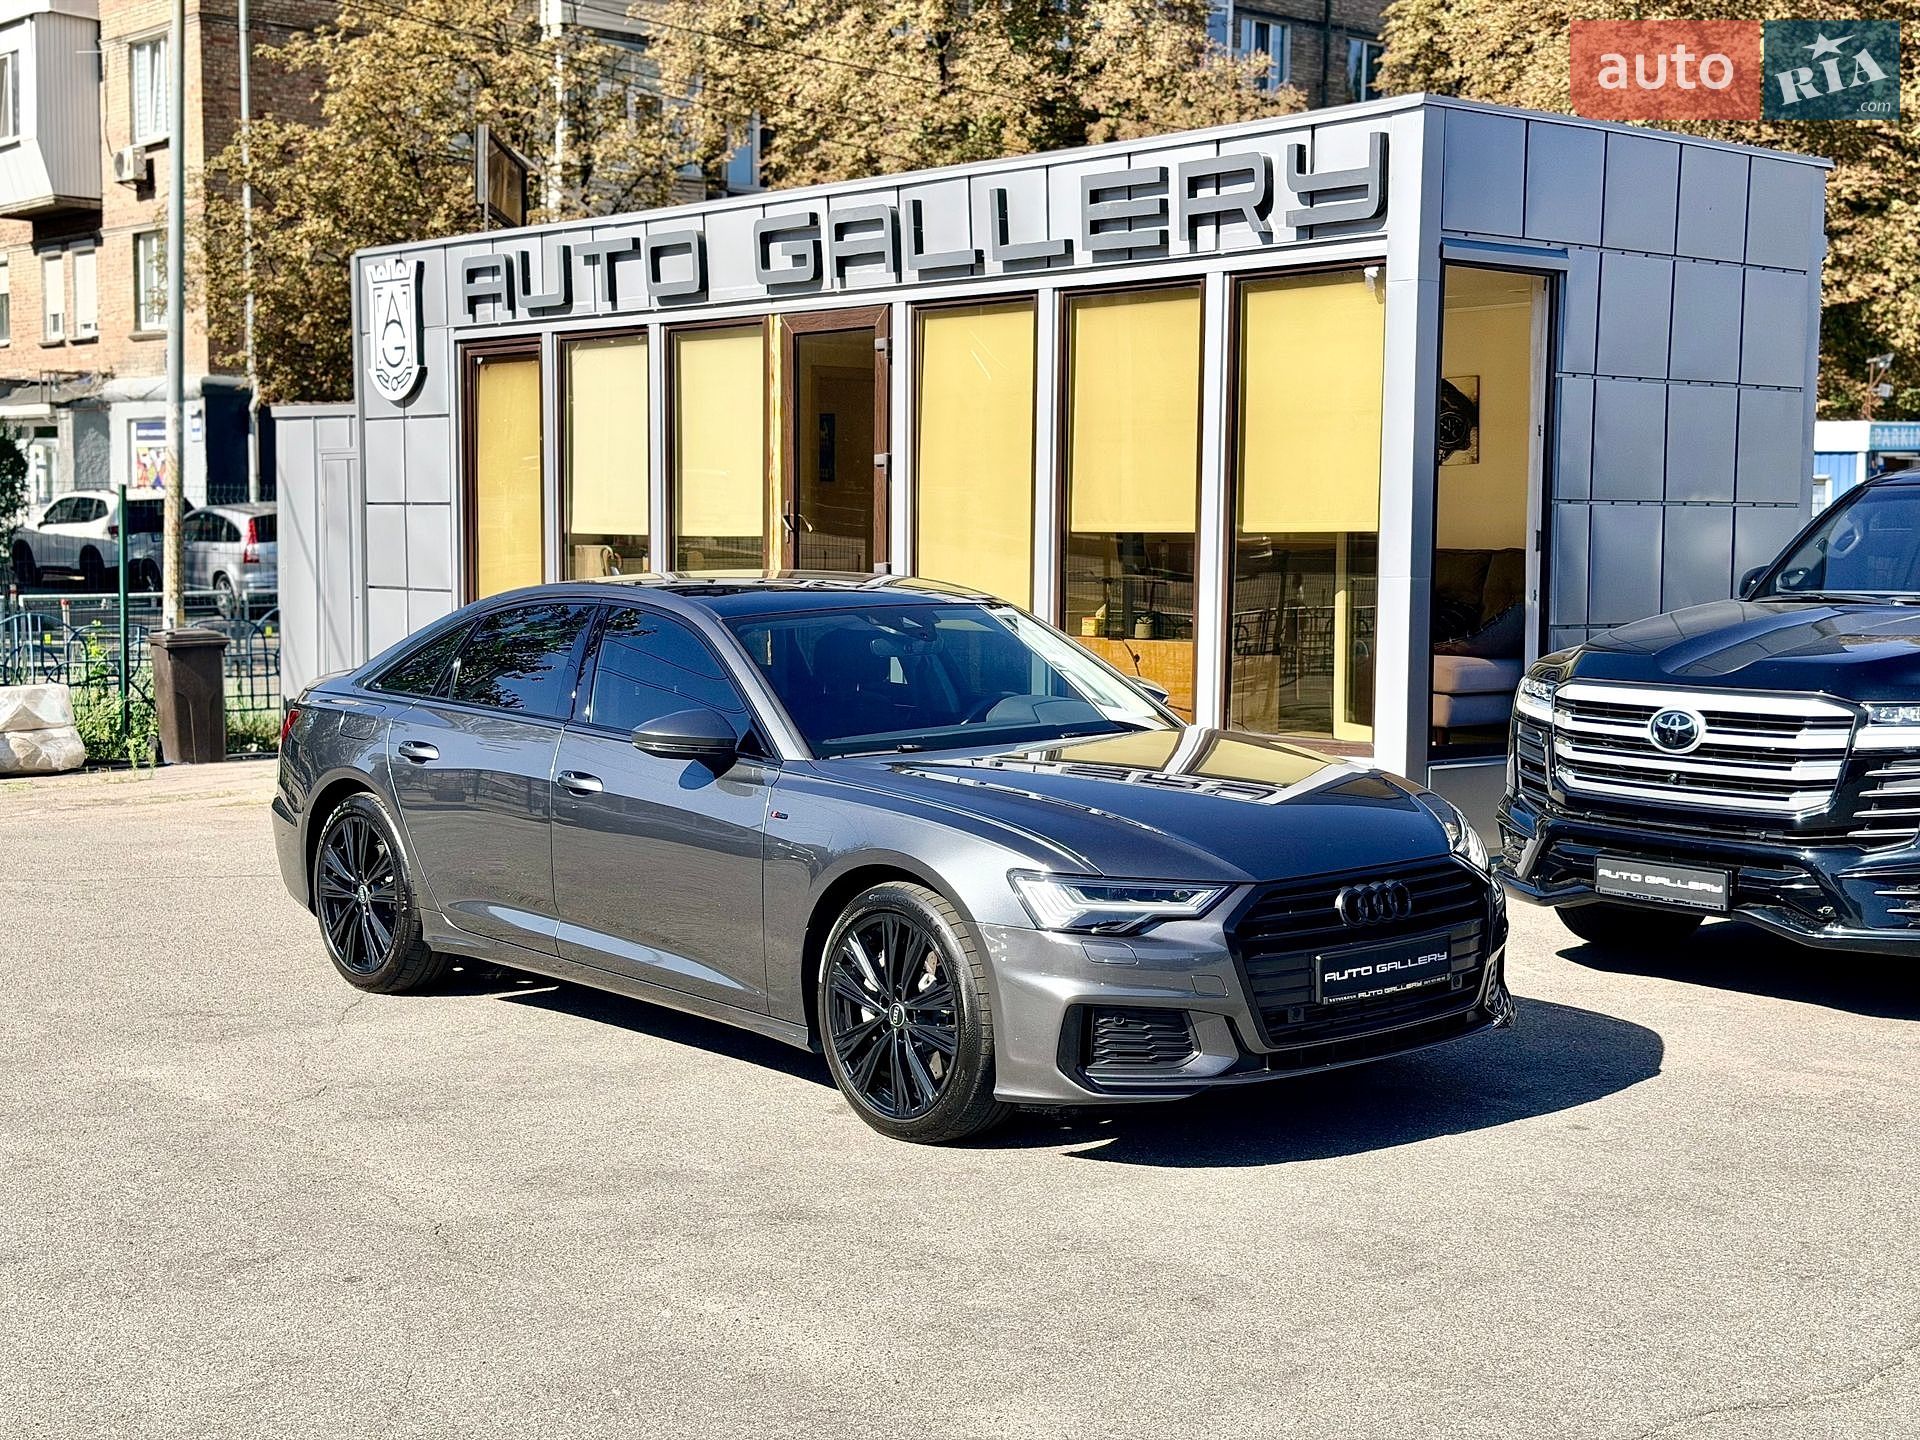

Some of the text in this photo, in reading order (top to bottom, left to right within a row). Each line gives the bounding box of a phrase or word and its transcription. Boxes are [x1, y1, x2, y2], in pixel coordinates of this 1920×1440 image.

[461, 131, 1388, 318] AUTO GALLERY
[1598, 868, 1642, 883] AUTO
[1644, 876, 1723, 894] GALLERY
[1625, 891, 1650, 900] AUTO
[1650, 895, 1691, 906] GALLERY
[1324, 951, 1447, 982] AUTO GALLERY
[1357, 981, 1422, 998] AUTO GALLERY
